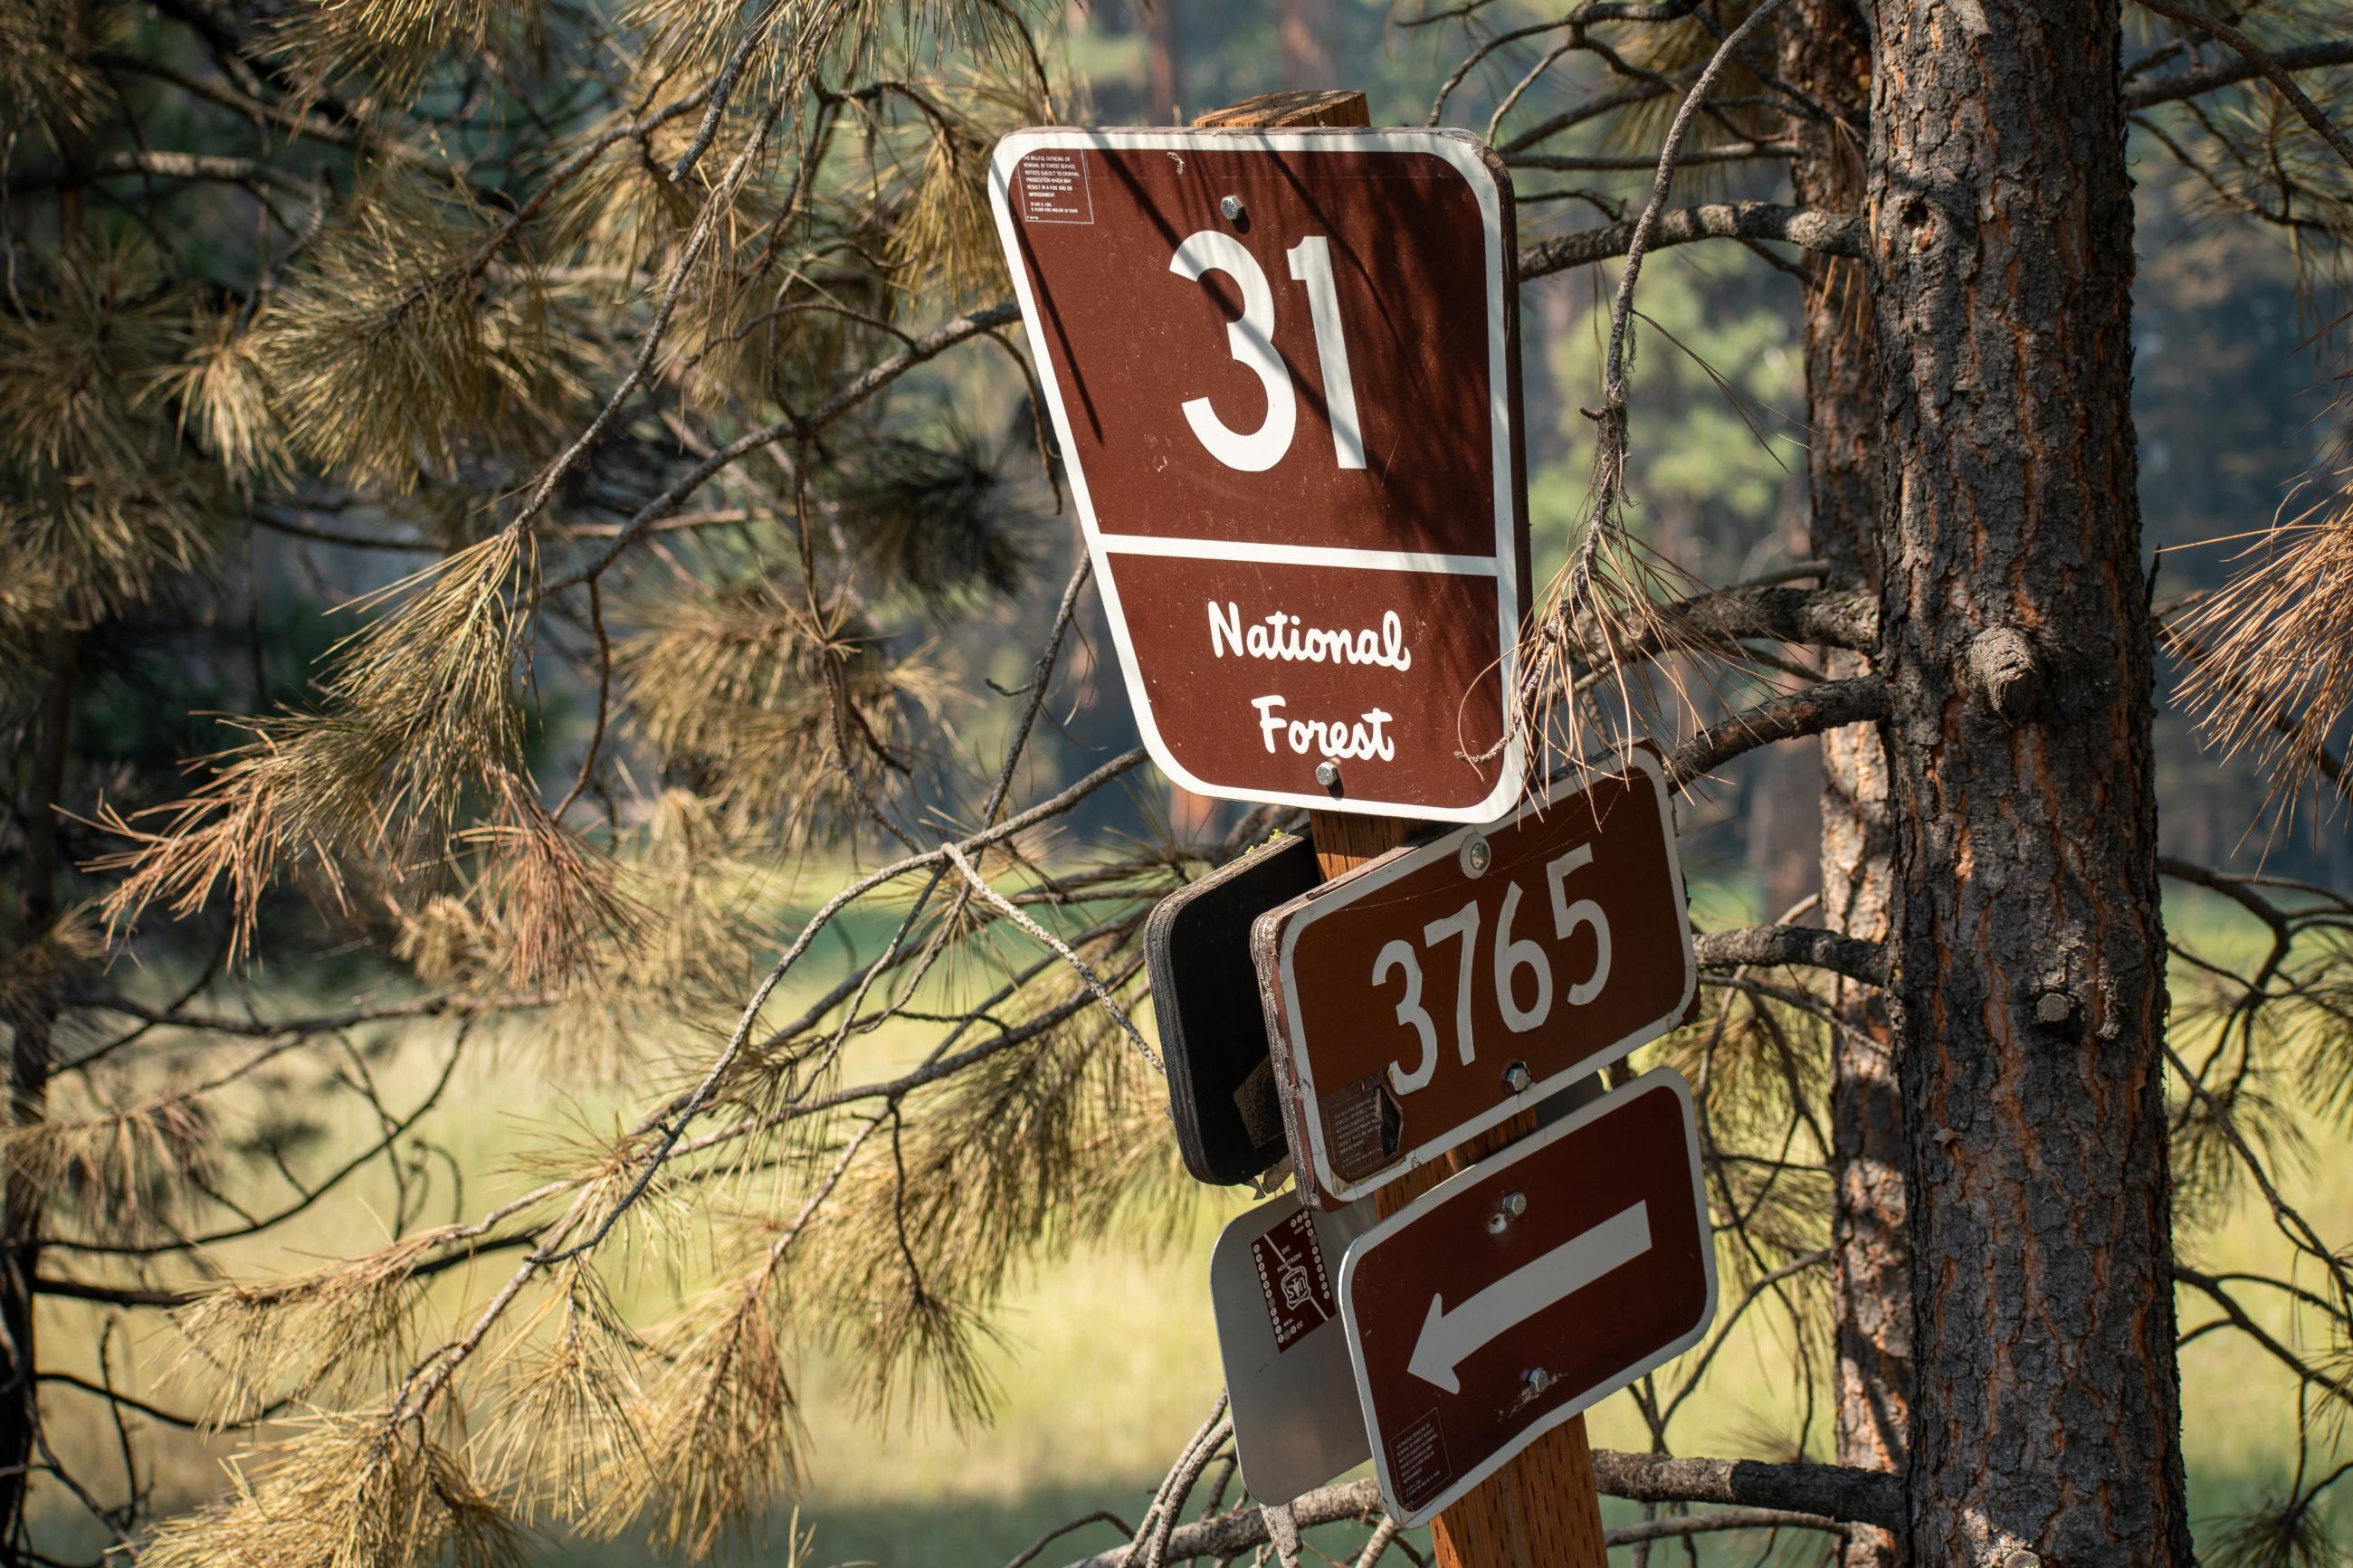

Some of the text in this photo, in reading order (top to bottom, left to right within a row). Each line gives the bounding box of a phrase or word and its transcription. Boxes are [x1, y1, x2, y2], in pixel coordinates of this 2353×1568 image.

[1168, 230, 1367, 471] 31
[1208, 601, 1412, 671] National
[1251, 695, 1395, 761] Forest
[1372, 842, 1612, 1096] 3765
